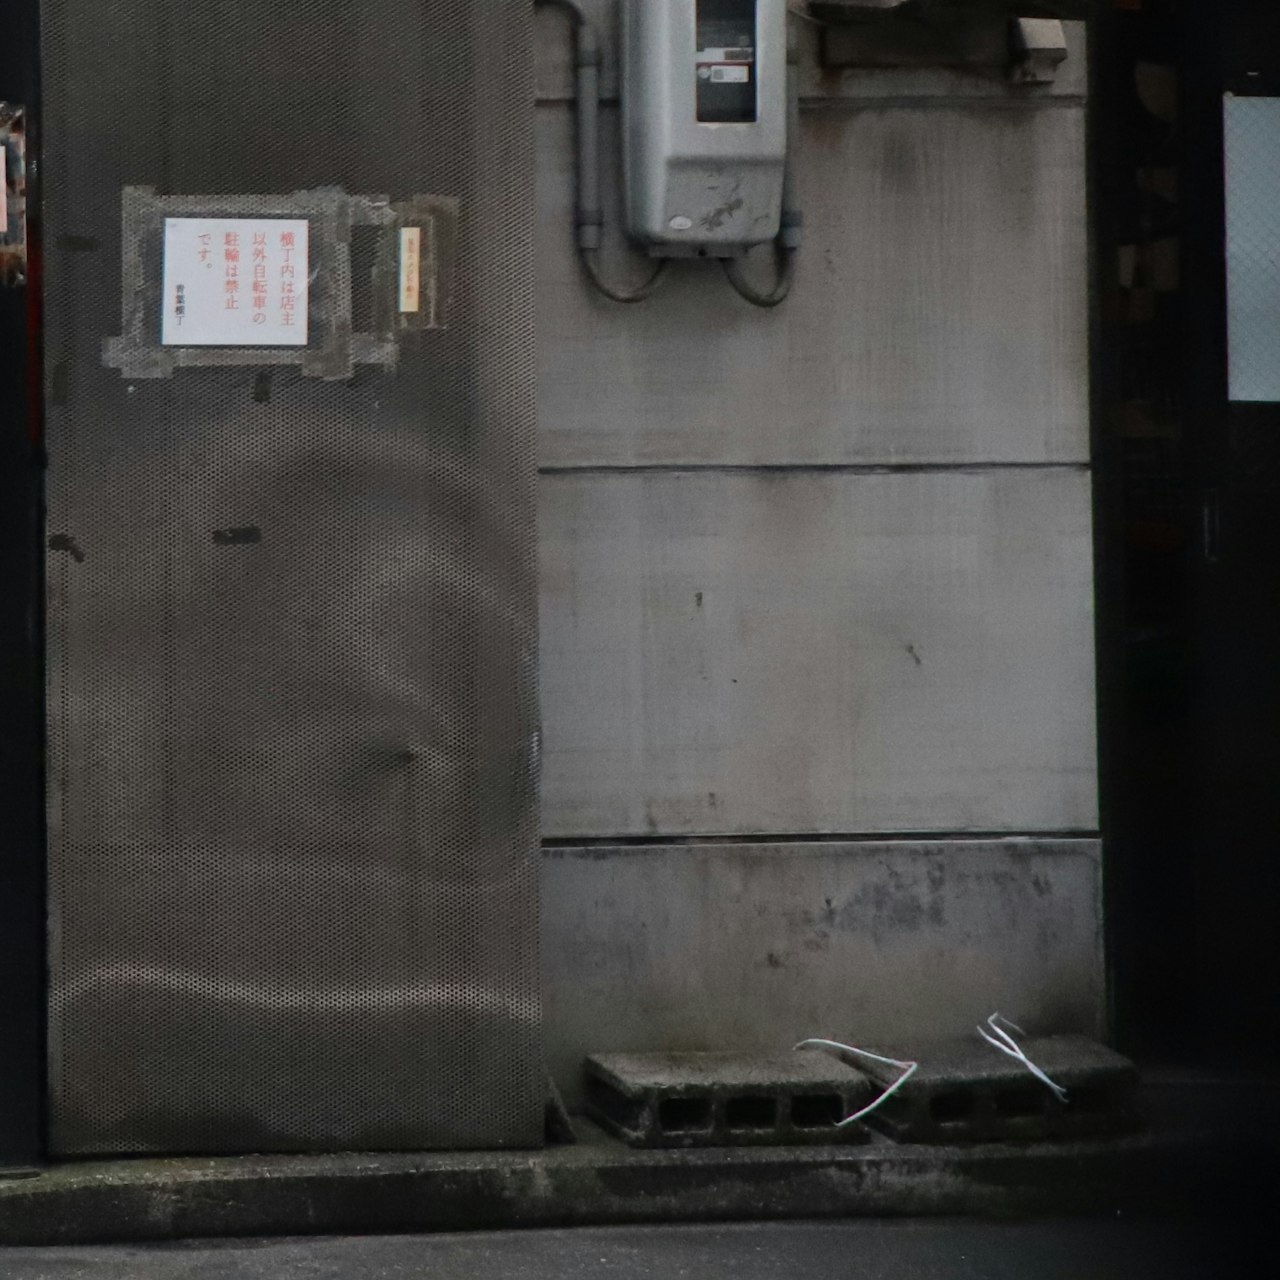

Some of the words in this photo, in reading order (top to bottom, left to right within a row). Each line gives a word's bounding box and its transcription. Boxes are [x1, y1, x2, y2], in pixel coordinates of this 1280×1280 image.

[197, 233, 213, 270] です。
[224, 231, 240, 311] 駐輪は禁止
[252, 231, 268, 326] 以外自転車の
[280, 231, 296, 327] 横丁内は店主
